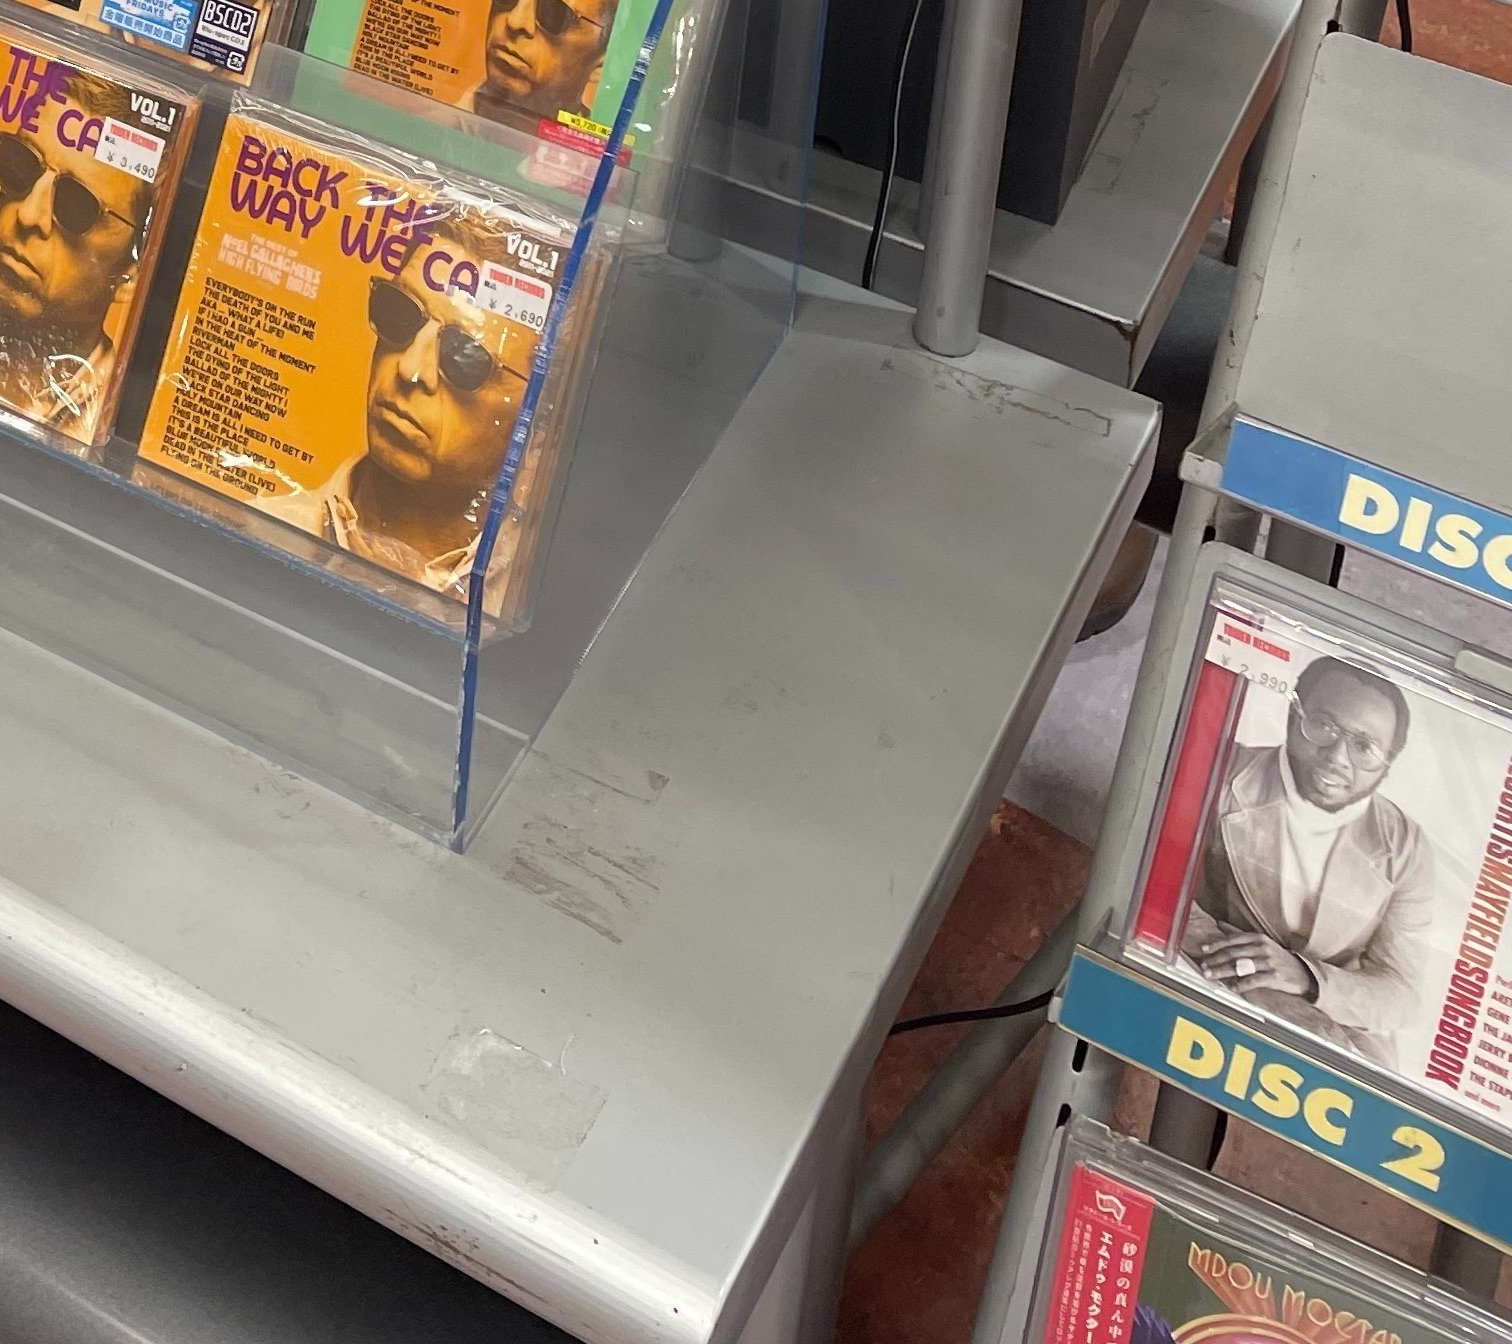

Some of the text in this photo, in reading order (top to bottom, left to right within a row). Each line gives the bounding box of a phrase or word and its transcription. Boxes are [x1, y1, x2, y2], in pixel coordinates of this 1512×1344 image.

[204, 0, 252, 35] BSCD2
[56, 109, 104, 157] CA
[130, 92, 177, 125] VOL.1
[235, 134, 348, 210] BACK
[230, 170, 480, 298] WAY WE CA
[505, 230, 560, 272] VOL.1
[205, 276, 316, 330] EVERYBODY'S ON THE RUN
[1165, 1015, 1447, 1193] DISC 2
[1187, 1241, 1272, 1299] MDOU
